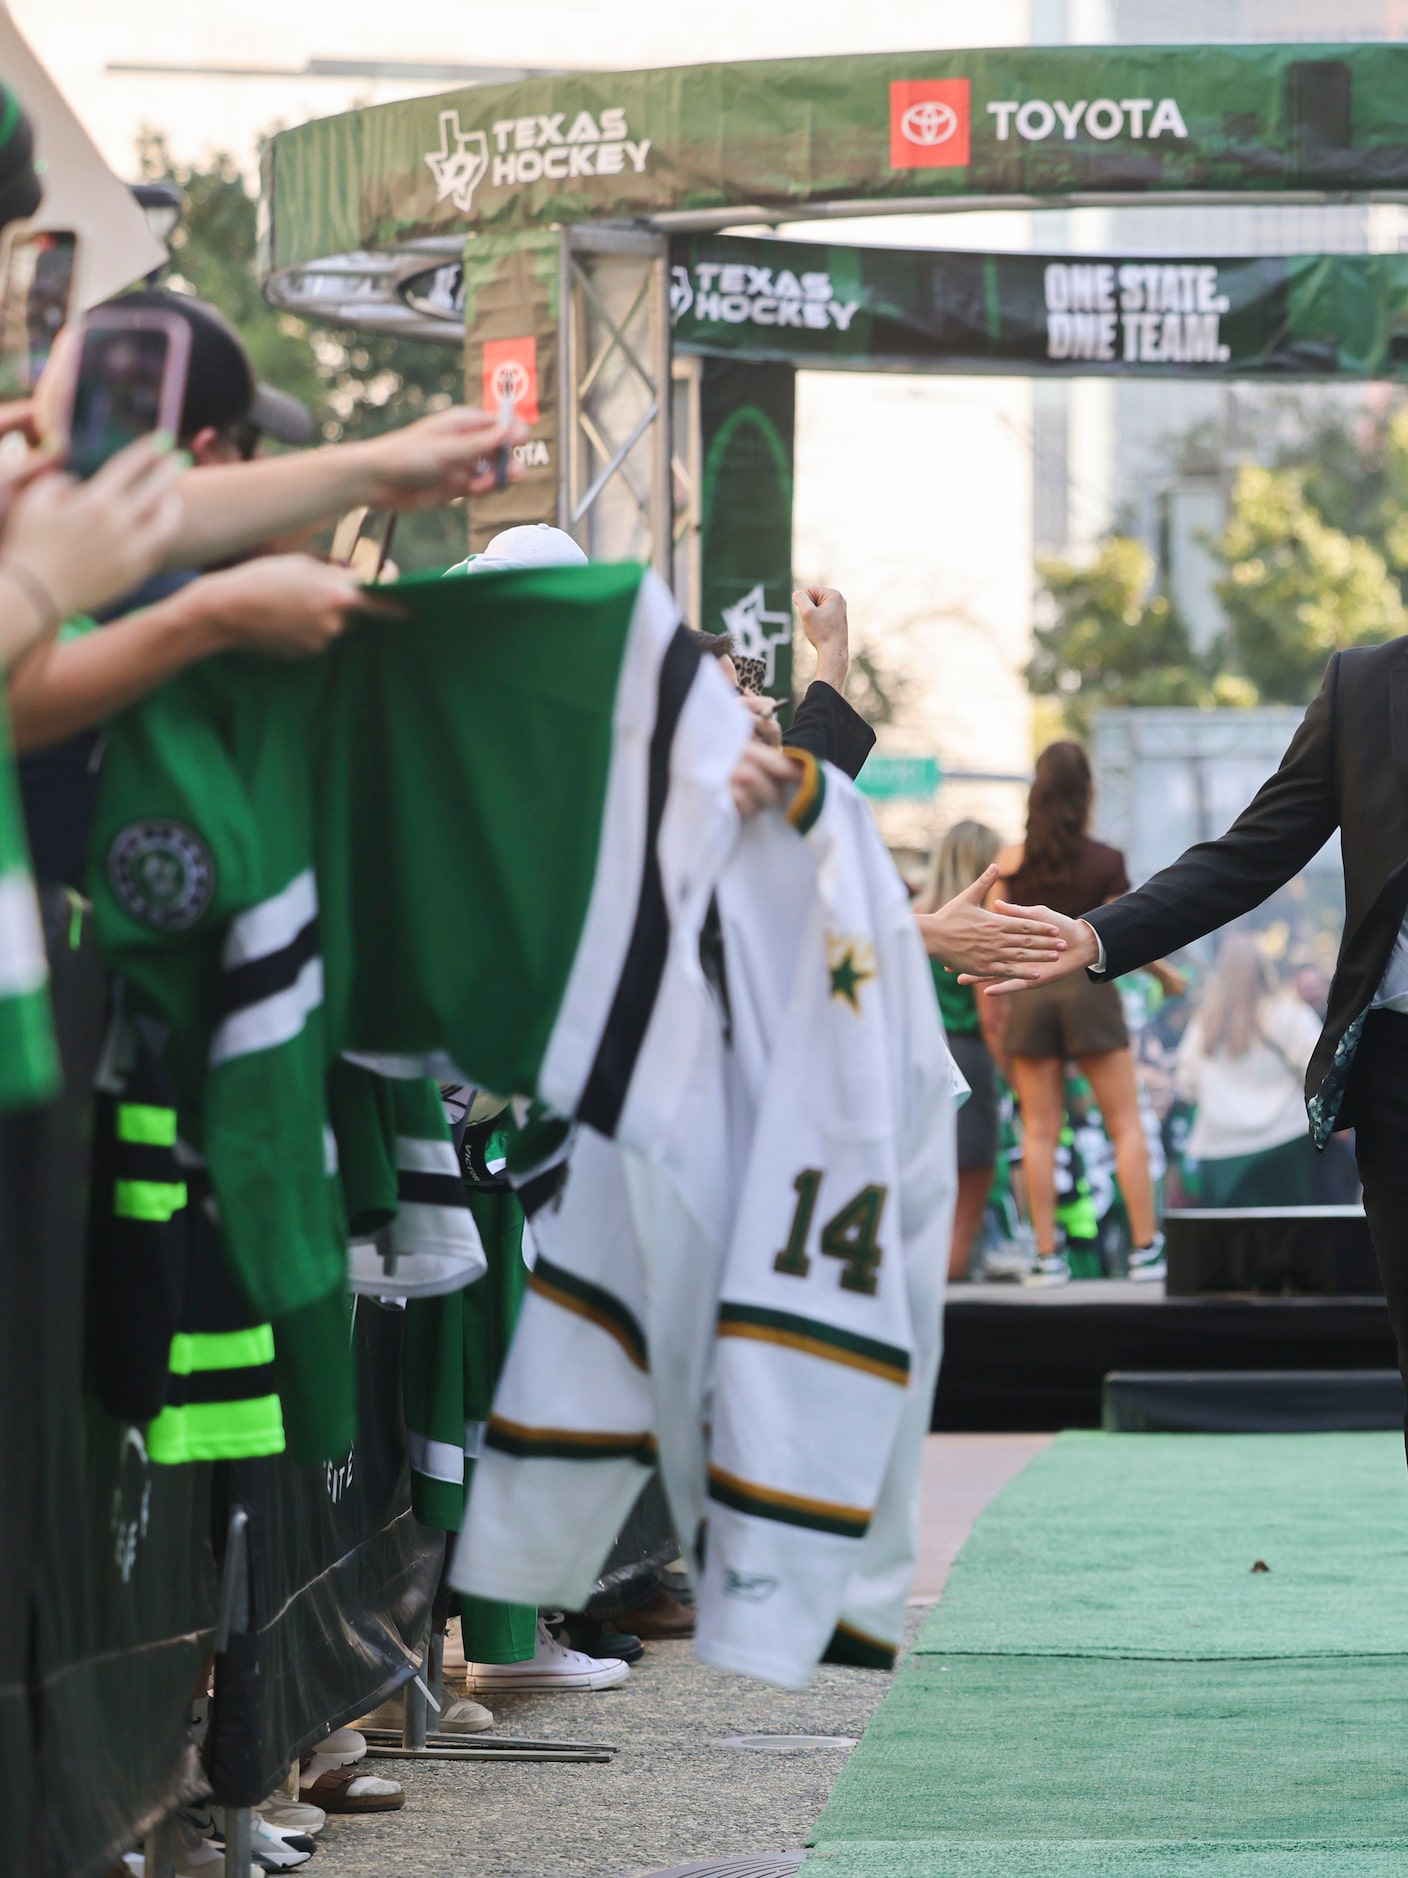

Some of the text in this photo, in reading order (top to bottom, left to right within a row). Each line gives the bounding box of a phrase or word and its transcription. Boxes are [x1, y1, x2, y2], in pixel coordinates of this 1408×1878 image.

[493, 107, 628, 152] TEXAS
[987, 98, 1187, 141] TOYOTA
[493, 140, 653, 187] HOCKEY
[695, 263, 832, 302] TEXAS
[1045, 264, 1230, 314] ONE STATE.
[695, 291, 860, 331] HOCKEY
[1046, 311, 1231, 363] ONE TEAM.
[513, 440, 550, 466] OTA
[773, 1168, 888, 1295] 14
